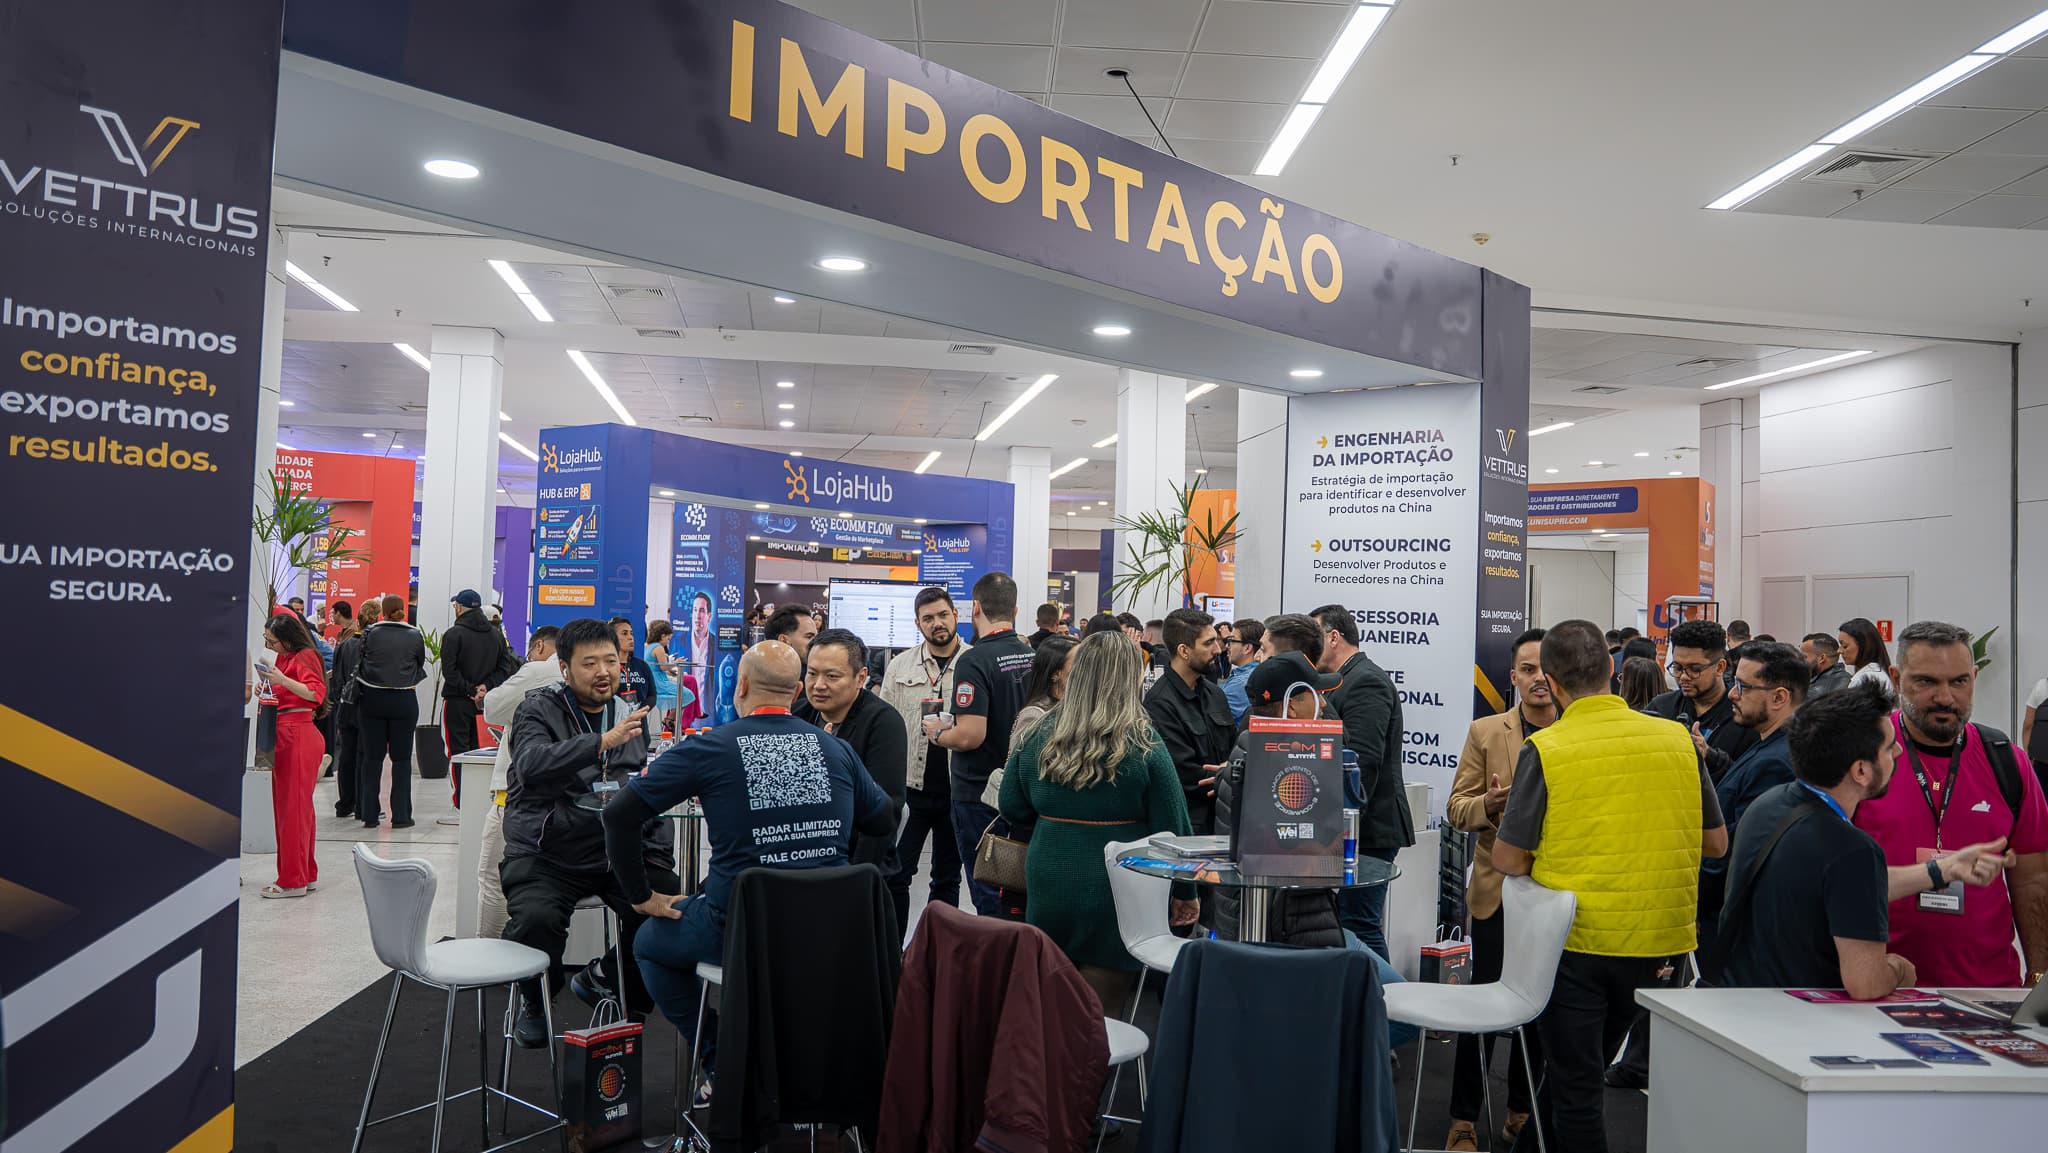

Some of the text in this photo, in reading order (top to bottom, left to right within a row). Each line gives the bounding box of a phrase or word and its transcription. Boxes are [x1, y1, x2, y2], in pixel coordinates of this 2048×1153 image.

[728, 19, 1344, 303] IMPORTAÇÃO
[0, 159, 258, 239] VETTRUS
[107, 219, 256, 257] INTERNACIONAIS
[2, 298, 237, 354] Importamos
[20, 351, 217, 397] confiança,
[0, 391, 230, 433] exportamos
[1335, 430, 1445, 447] ENGENHARIA
[9, 435, 218, 472] resultados.
[1313, 446, 1453, 467] DA IMPORTAÇÃO
[1484, 455, 1527, 478] VETTRUS
[813, 468, 893, 503] LojaHub
[1311, 472, 1454, 486] Estratégia de importação
[540, 487, 579, 499] HUB & ERP
[1300, 487, 1467, 503] para identificar e desenvolver
[1575, 493, 1620, 501] DIRETAMENTE
[1329, 502, 1432, 516] produtos na China
[830, 518, 866, 533] ECOMM
[868, 521, 893, 536] FLOW
[1485, 511, 1523, 528] Importamos
[938, 537, 970, 549] LojaHub
[1329, 538, 1451, 552] OUTSOURCING
[51, 545, 234, 575] IMPORTAÇÃO
[1485, 549, 1522, 561] exportamos
[1313, 559, 1447, 570] Desenvolver Produtos e
[1314, 574, 1444, 586] Fornecedores na China
[50, 580, 172, 602] SEGURA.
[1481, 609, 1491, 619] SUA
[752, 819, 841, 837] RADAR ILIMITADO
[762, 835, 783, 844] PARA
[790, 832, 806, 840] SUA
[807, 829, 839, 838] EMPRESA
[760, 852, 789, 864] FALE
